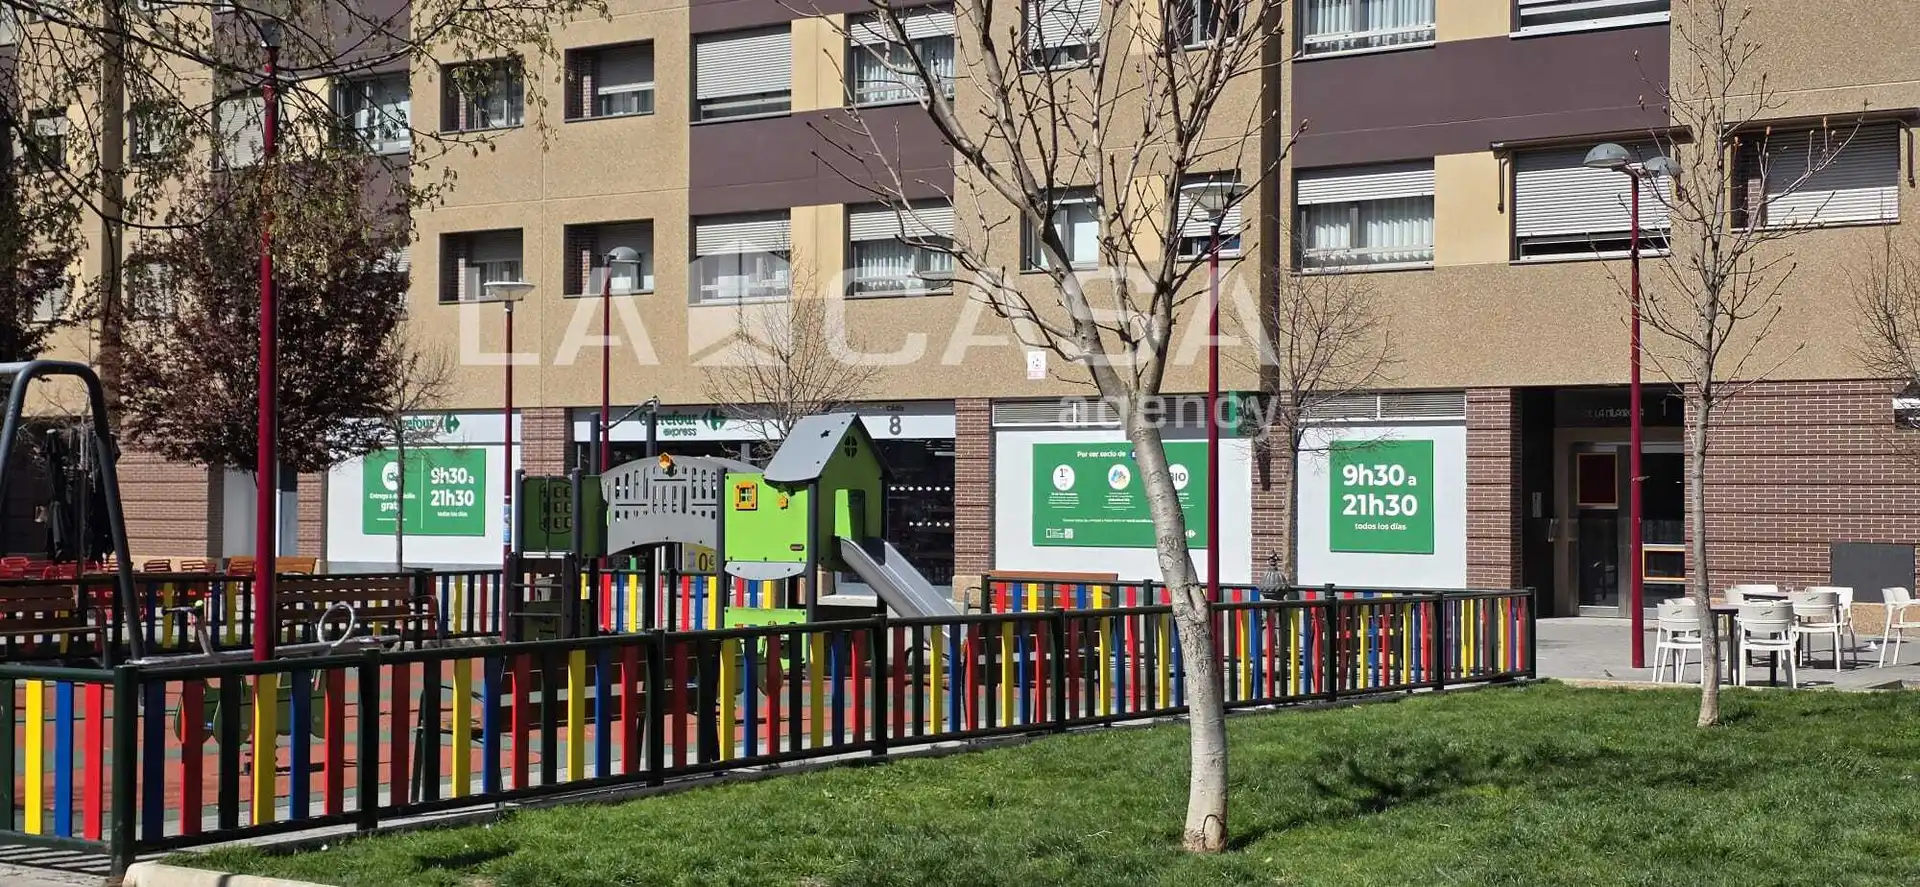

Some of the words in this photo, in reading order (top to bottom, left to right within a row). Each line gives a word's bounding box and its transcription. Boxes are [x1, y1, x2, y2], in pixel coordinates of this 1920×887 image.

[638, 411, 698, 426] Crrefour
[889, 415, 901, 436] 8
[663, 427, 697, 438] express
[1076, 450, 1088, 458] Por
[1099, 450, 1117, 458] socio
[430, 467, 468, 485] 9h30
[468, 476, 475, 485] a
[1342, 464, 1405, 487] 9h30
[1407, 475, 1417, 486] a
[430, 489, 475, 507] 21h30
[1342, 493, 1418, 517] 21h30
[380, 501, 399, 512] grat
[1354, 521, 1377, 530] todos
[1377, 521, 1389, 530] los
[1390, 522, 1408, 531] días
